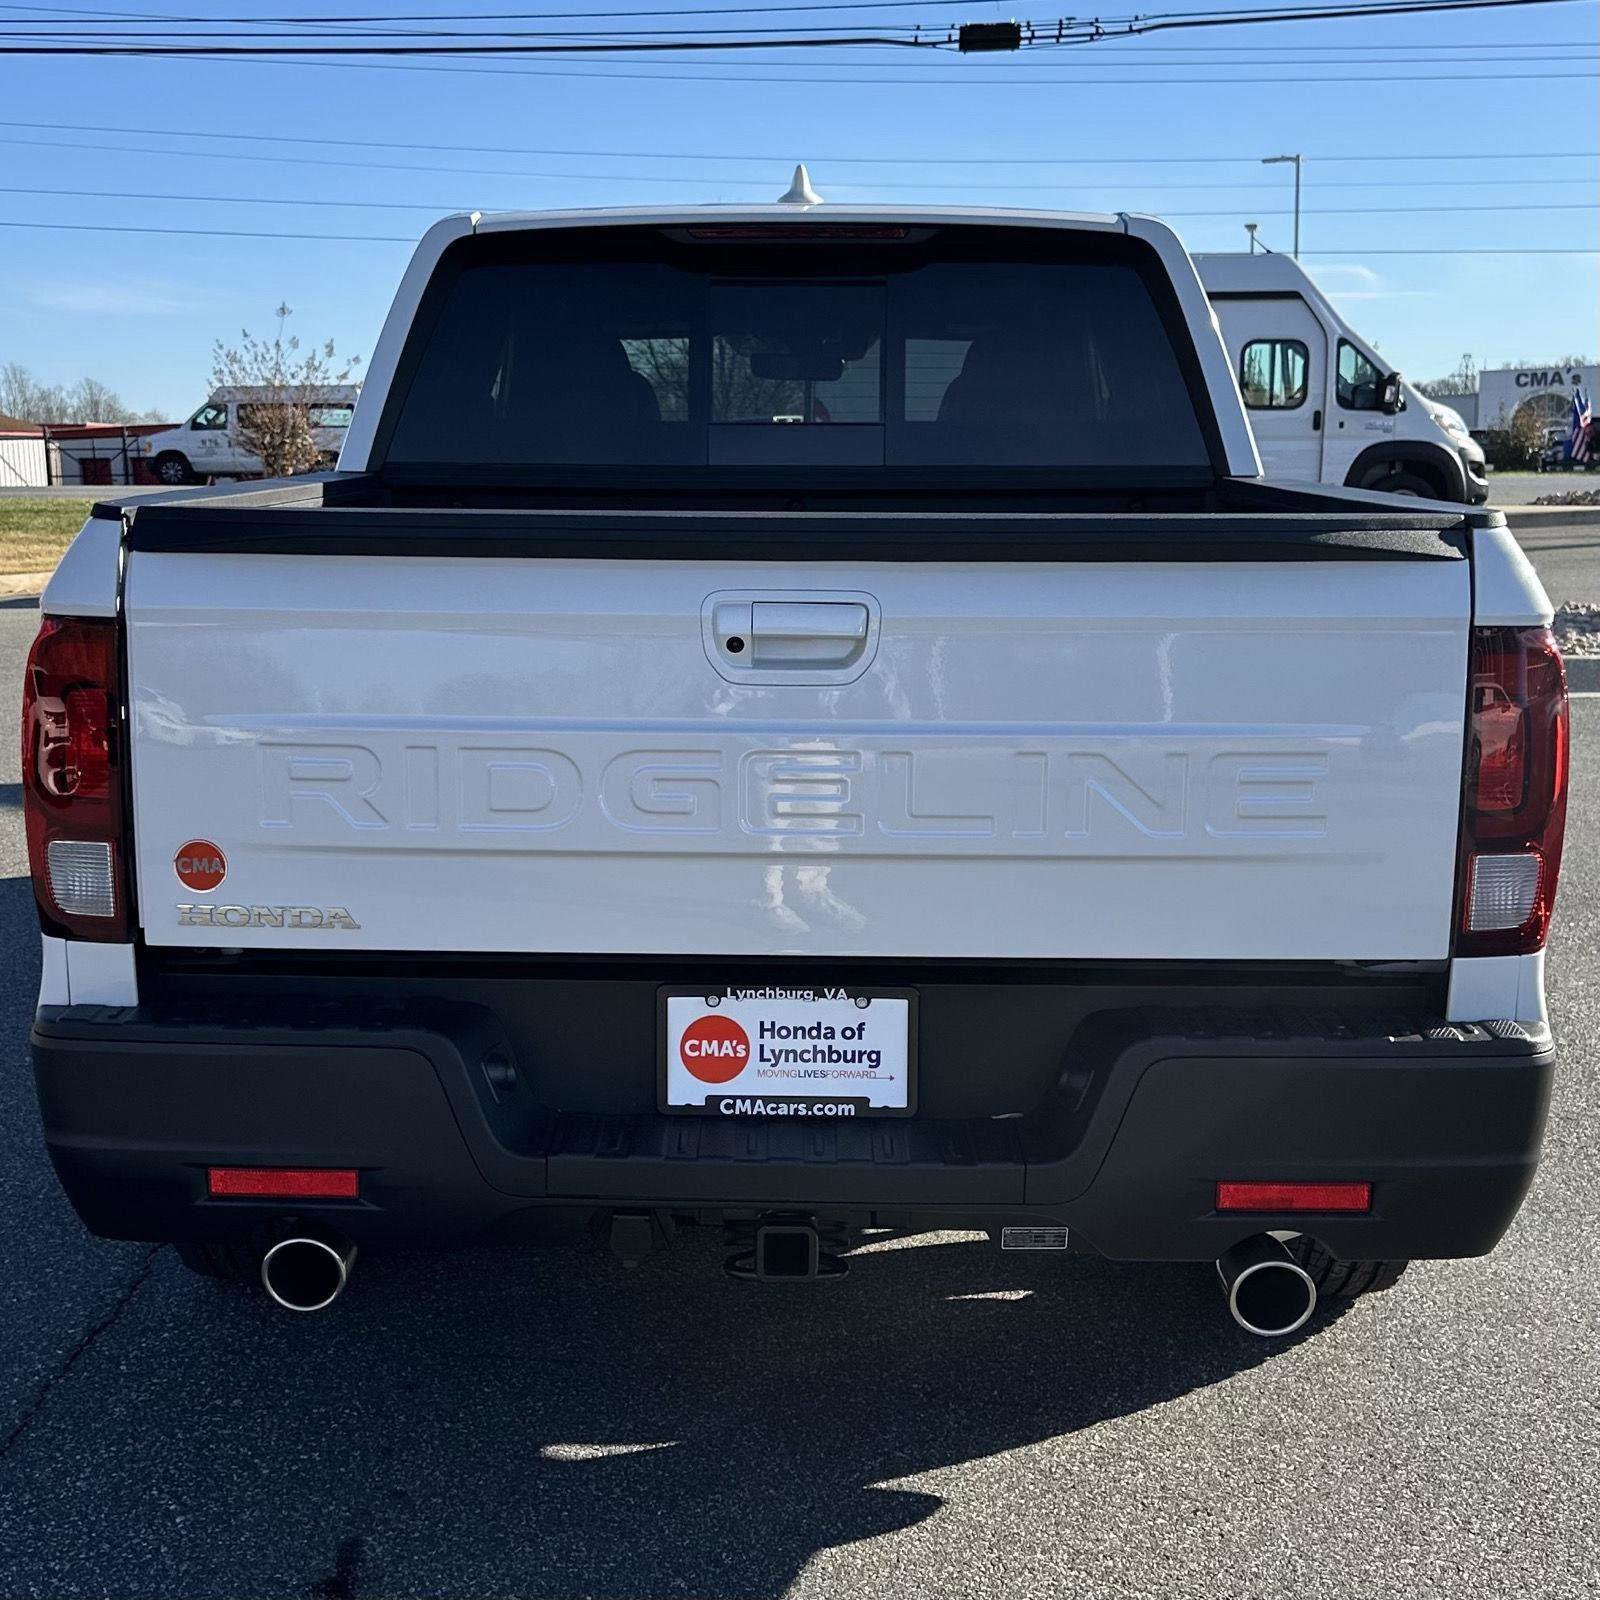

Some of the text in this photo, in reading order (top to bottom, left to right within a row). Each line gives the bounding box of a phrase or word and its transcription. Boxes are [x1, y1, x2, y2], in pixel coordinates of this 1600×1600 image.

[1515, 367, 1582, 388] CMA's
[258, 741, 1329, 840] RIDGELINE
[177, 857, 225, 874] CMA
[176, 904, 361, 929] HONDA
[726, 987, 848, 1001] Lynchburg, VA
[759, 1021, 866, 1041] Honda of
[684, 1039, 747, 1058] CMA's
[759, 1044, 882, 1068] Lynchburg
[719, 1099, 856, 1116] CMAcars.com
